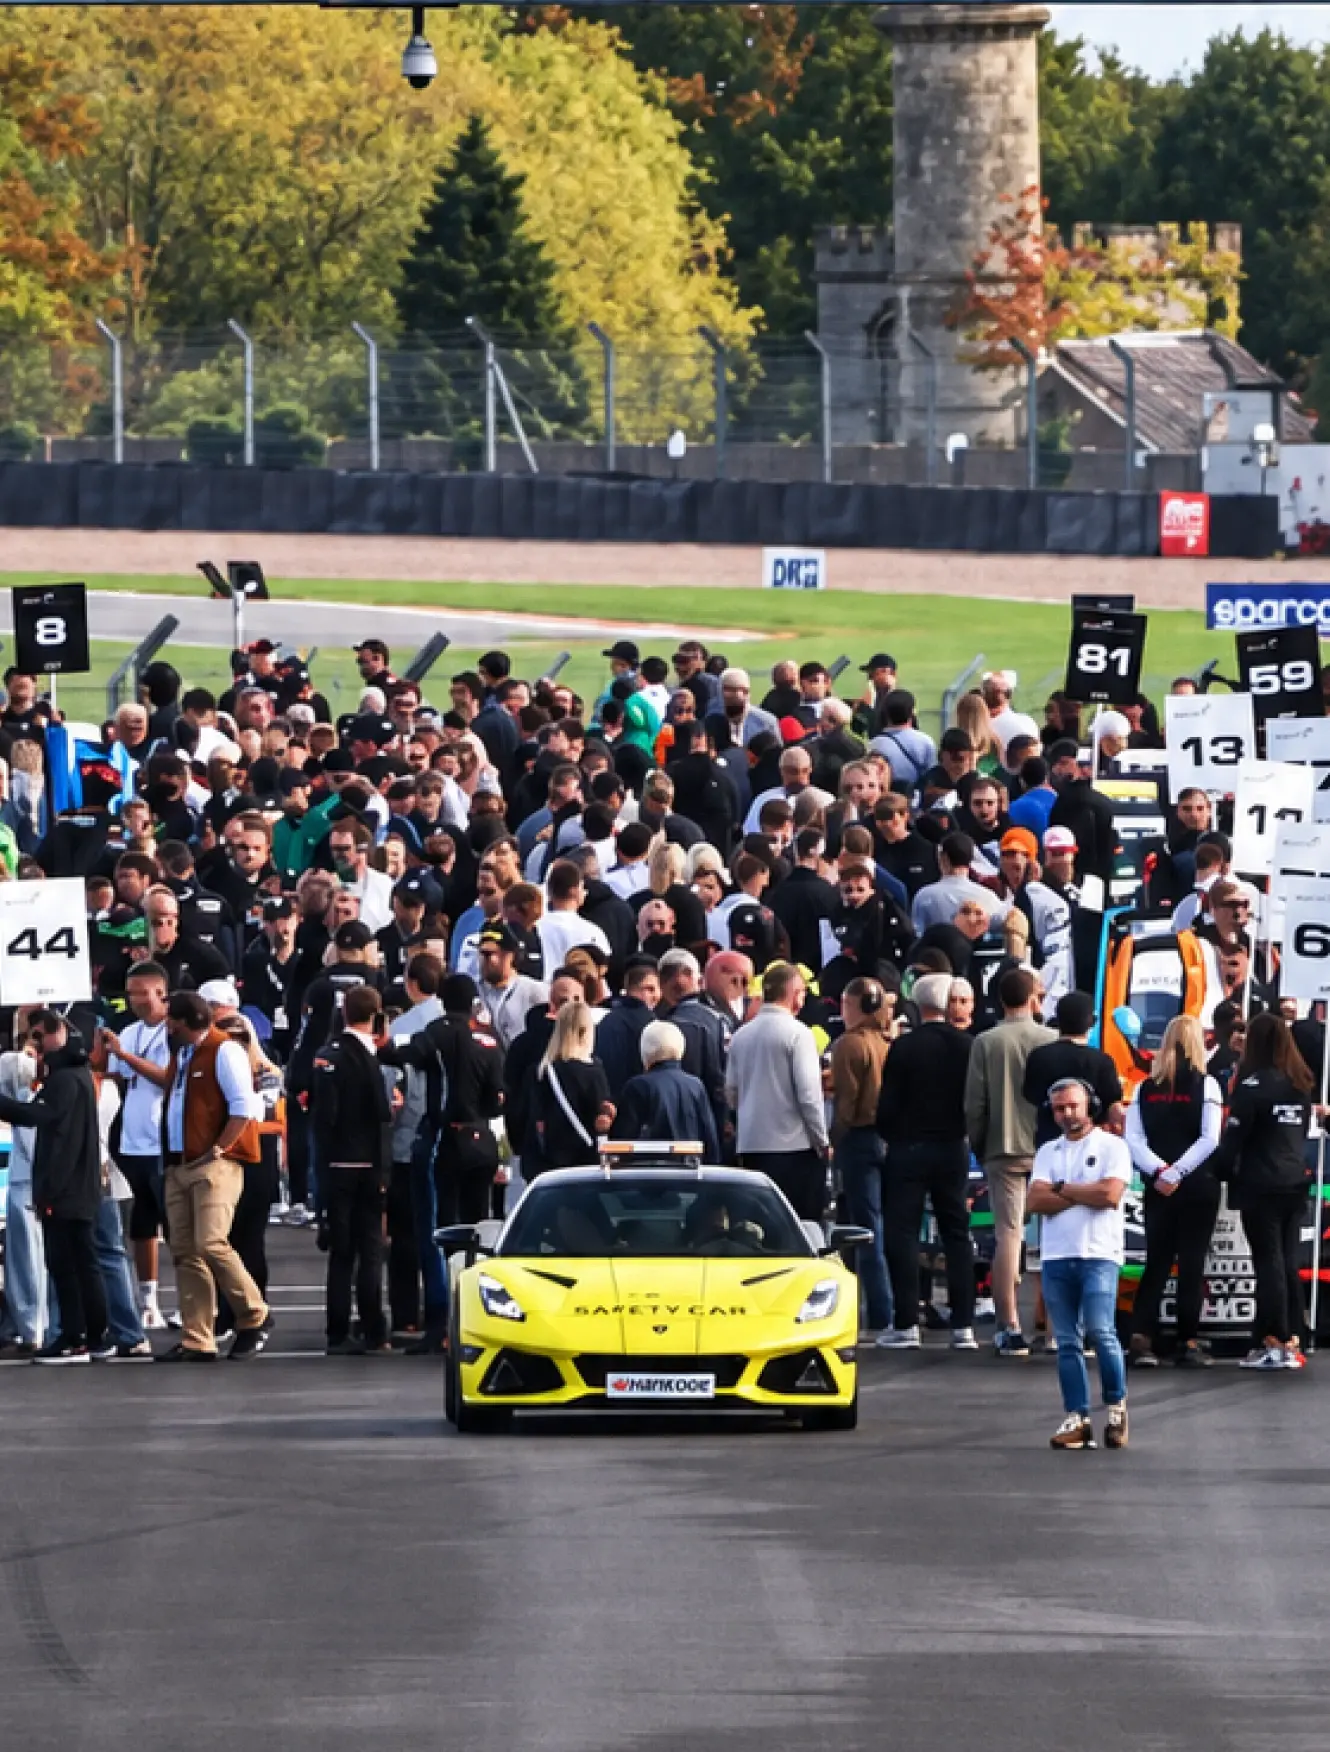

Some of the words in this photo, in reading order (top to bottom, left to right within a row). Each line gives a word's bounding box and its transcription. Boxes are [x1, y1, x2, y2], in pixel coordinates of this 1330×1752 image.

[35, 616, 66, 645] 8
[1076, 643, 1130, 675] 81
[1249, 661, 1314, 694] 59
[1180, 735, 1244, 767] 13
[7, 926, 80, 960] 44
[574, 1304, 680, 1316] SAFETY
[688, 1304, 746, 1316] CAR
